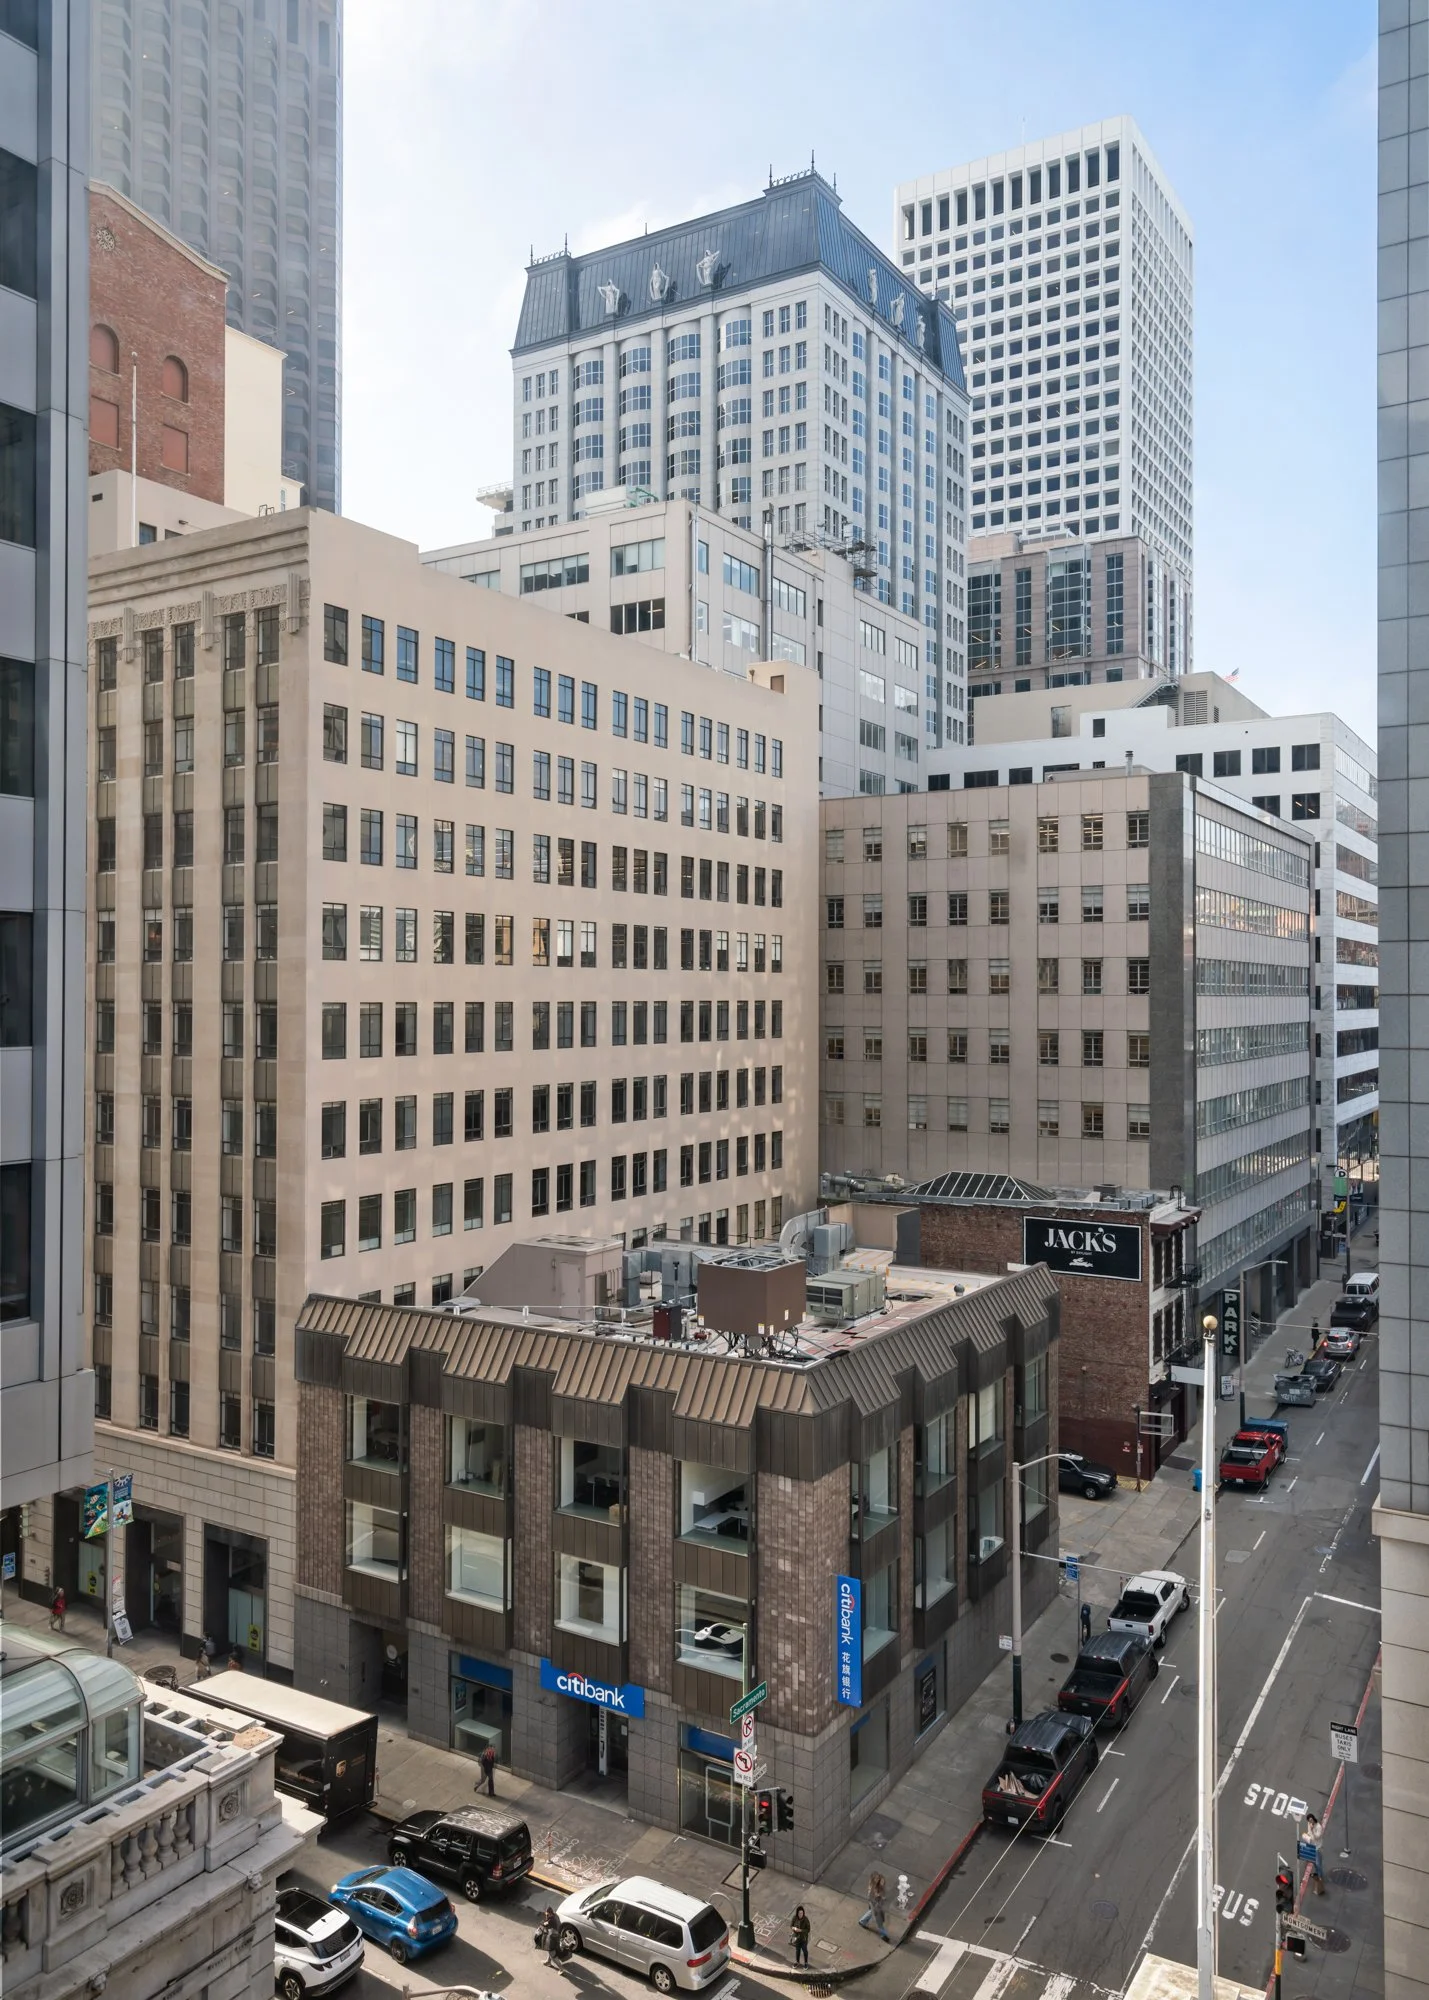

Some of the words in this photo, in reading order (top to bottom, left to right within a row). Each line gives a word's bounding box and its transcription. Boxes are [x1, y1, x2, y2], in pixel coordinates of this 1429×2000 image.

[1044, 1227, 1117, 1253] JACK'S
[1224, 1292, 1238, 1346] PARK
[841, 1583, 855, 1645] citibank
[556, 1673, 625, 1709] citibank
[733, 1688, 765, 1718] Sacramento
[1335, 1733, 1352, 1741] BUSES
[1283, 1914, 1327, 1938] MONTGOMERY
